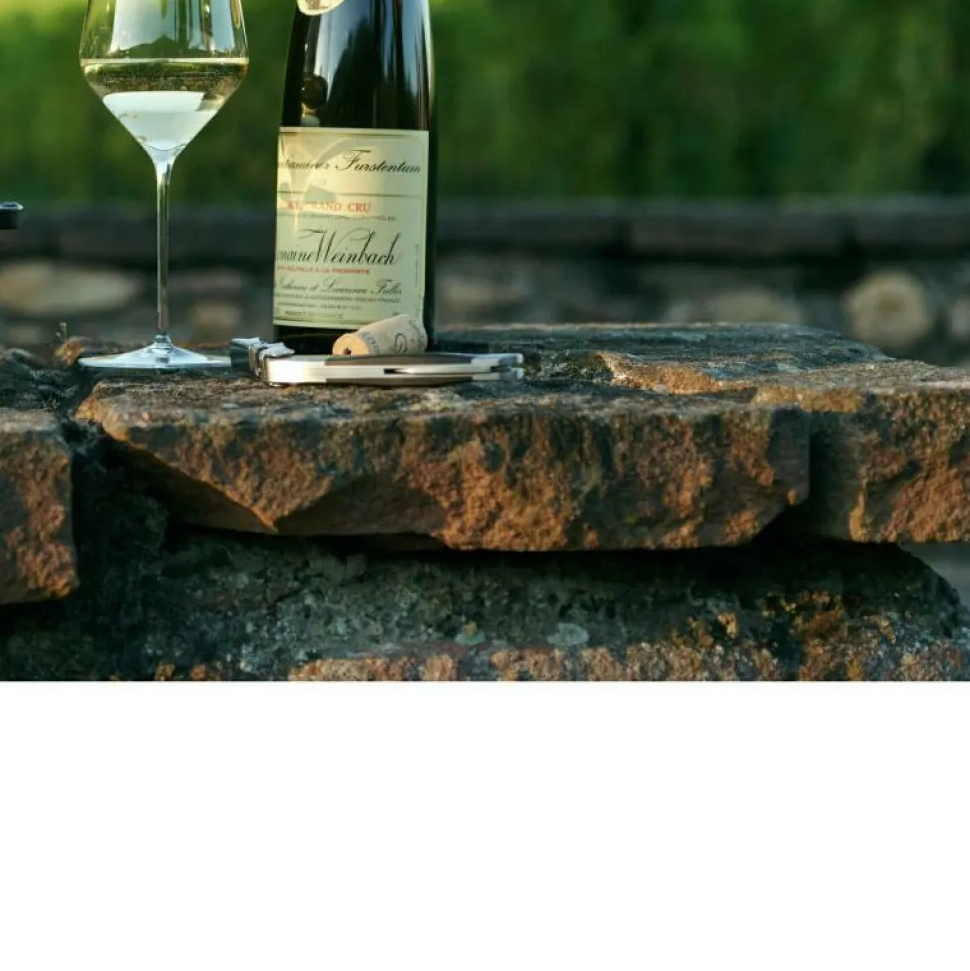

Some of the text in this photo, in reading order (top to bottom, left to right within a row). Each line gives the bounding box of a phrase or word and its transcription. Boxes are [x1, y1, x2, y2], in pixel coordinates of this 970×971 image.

[334, 149, 421, 174] Furstentum
[347, 202, 372, 214] CRU
[297, 226, 403, 266] Weinbach
